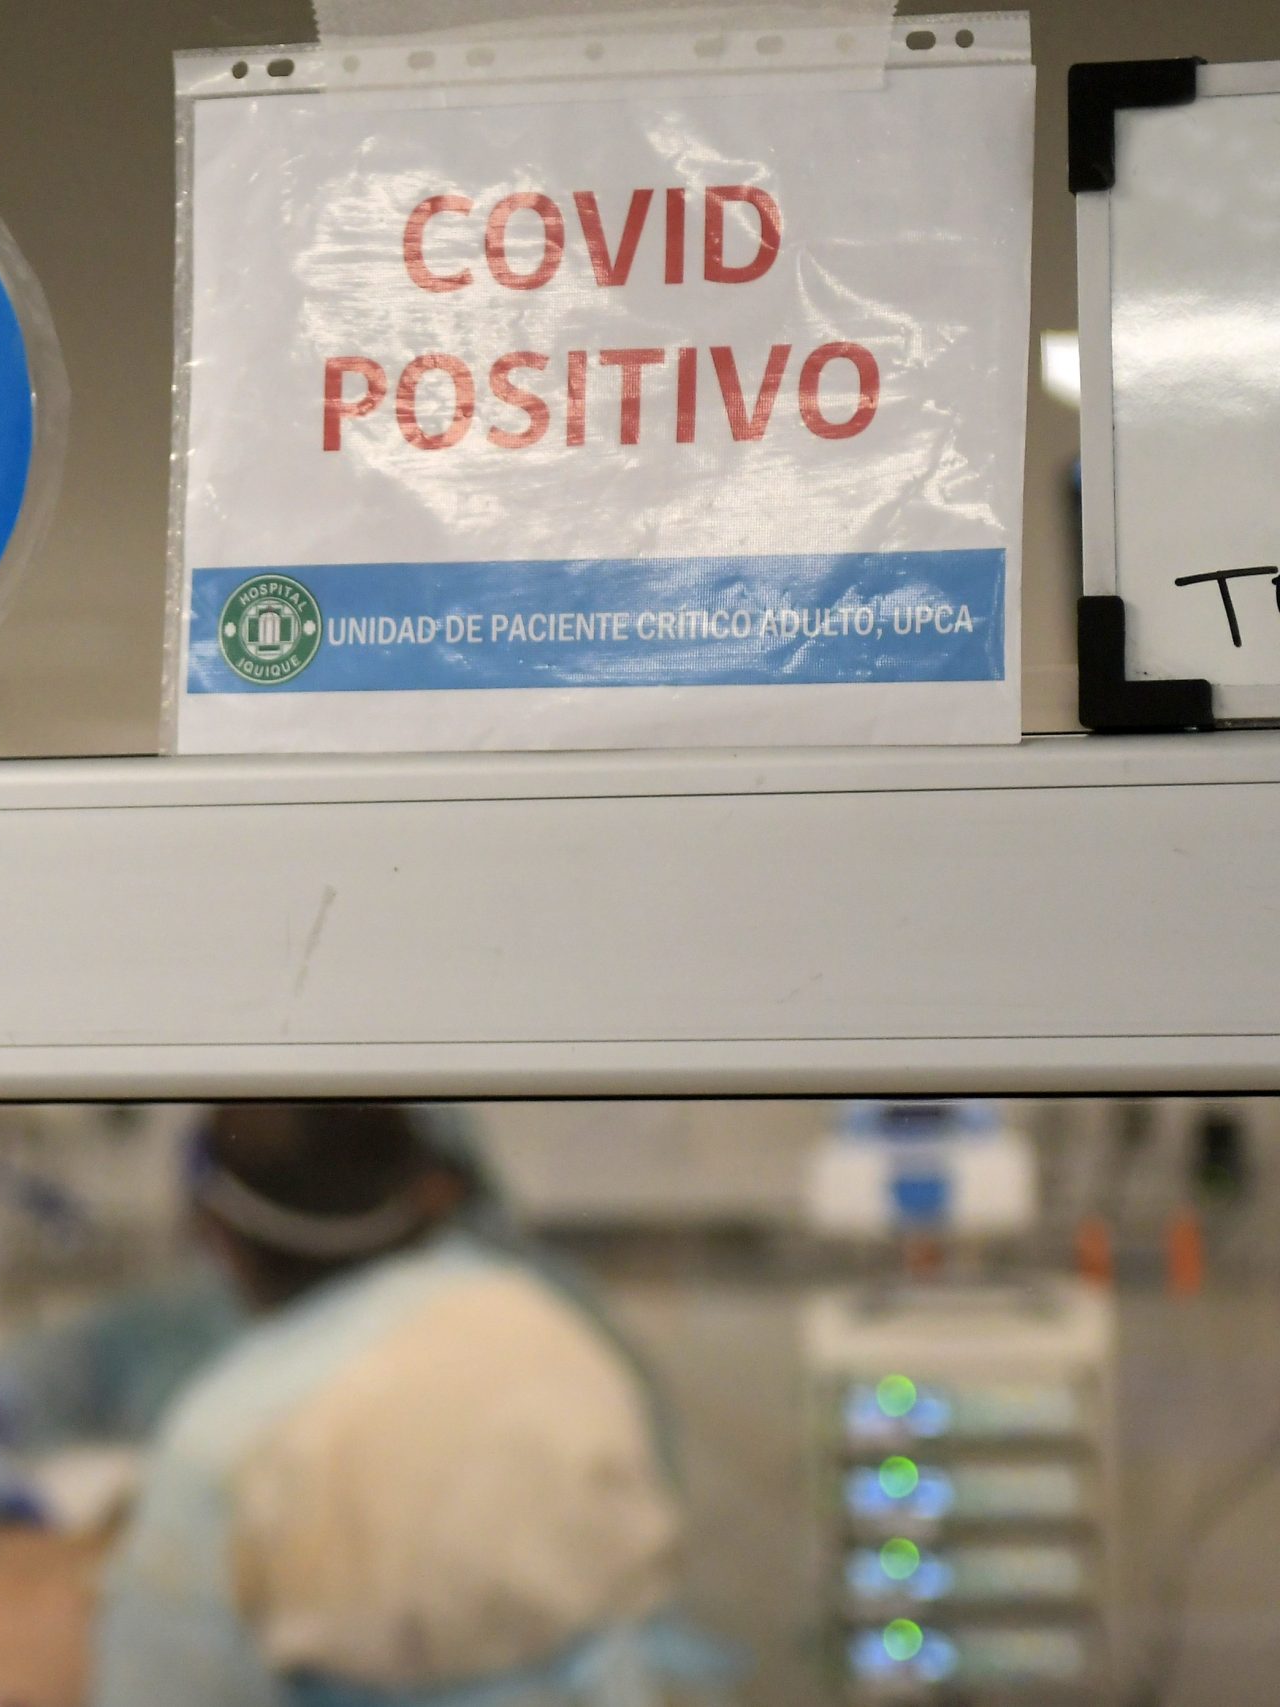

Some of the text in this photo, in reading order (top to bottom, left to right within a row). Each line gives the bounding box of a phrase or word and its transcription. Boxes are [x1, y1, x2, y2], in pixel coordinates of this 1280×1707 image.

[403, 185, 783, 293] COVID
[323, 341, 881, 452] POSITIVO
[240, 582, 307, 613] HOSPITAL
[328, 603, 975, 646] UNIDAD DE PACIENTE CRÍTICO ADULTO, UPCA
[1174, 565, 1280, 648] T
[235, 654, 301, 677] IQUIQUE
